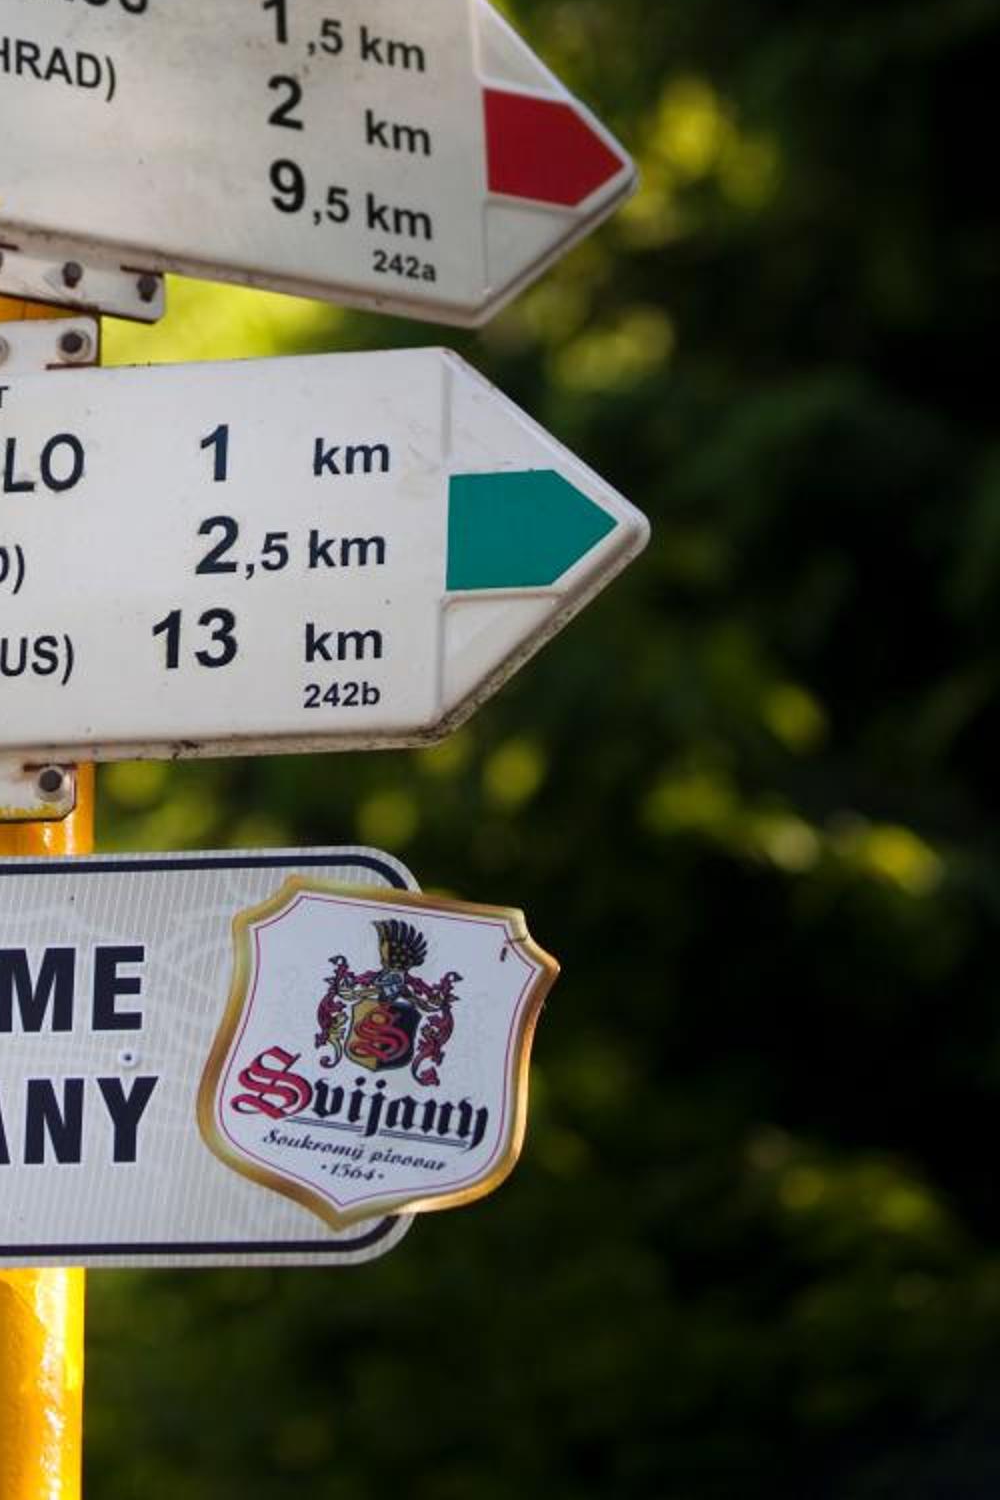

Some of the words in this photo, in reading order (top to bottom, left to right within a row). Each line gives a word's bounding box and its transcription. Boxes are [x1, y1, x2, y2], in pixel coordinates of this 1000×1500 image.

[360, 26, 426, 72] km
[268, 75, 305, 130] 2
[366, 109, 431, 156] km
[269, 158, 350, 225] 9,5
[366, 193, 433, 241] km
[372, 249, 437, 282] 242a
[200, 424, 230, 482] 1
[313, 437, 390, 476] km
[195, 515, 289, 579] 2,5
[308, 530, 386, 569] km
[151, 606, 238, 670] 13
[304, 622, 383, 662] km
[303, 682, 380, 708] 242b
[231, 1046, 489, 1152] Svijany
[262, 1128, 365, 1161] Soukromý
[368, 1146, 447, 1172] pivovar
